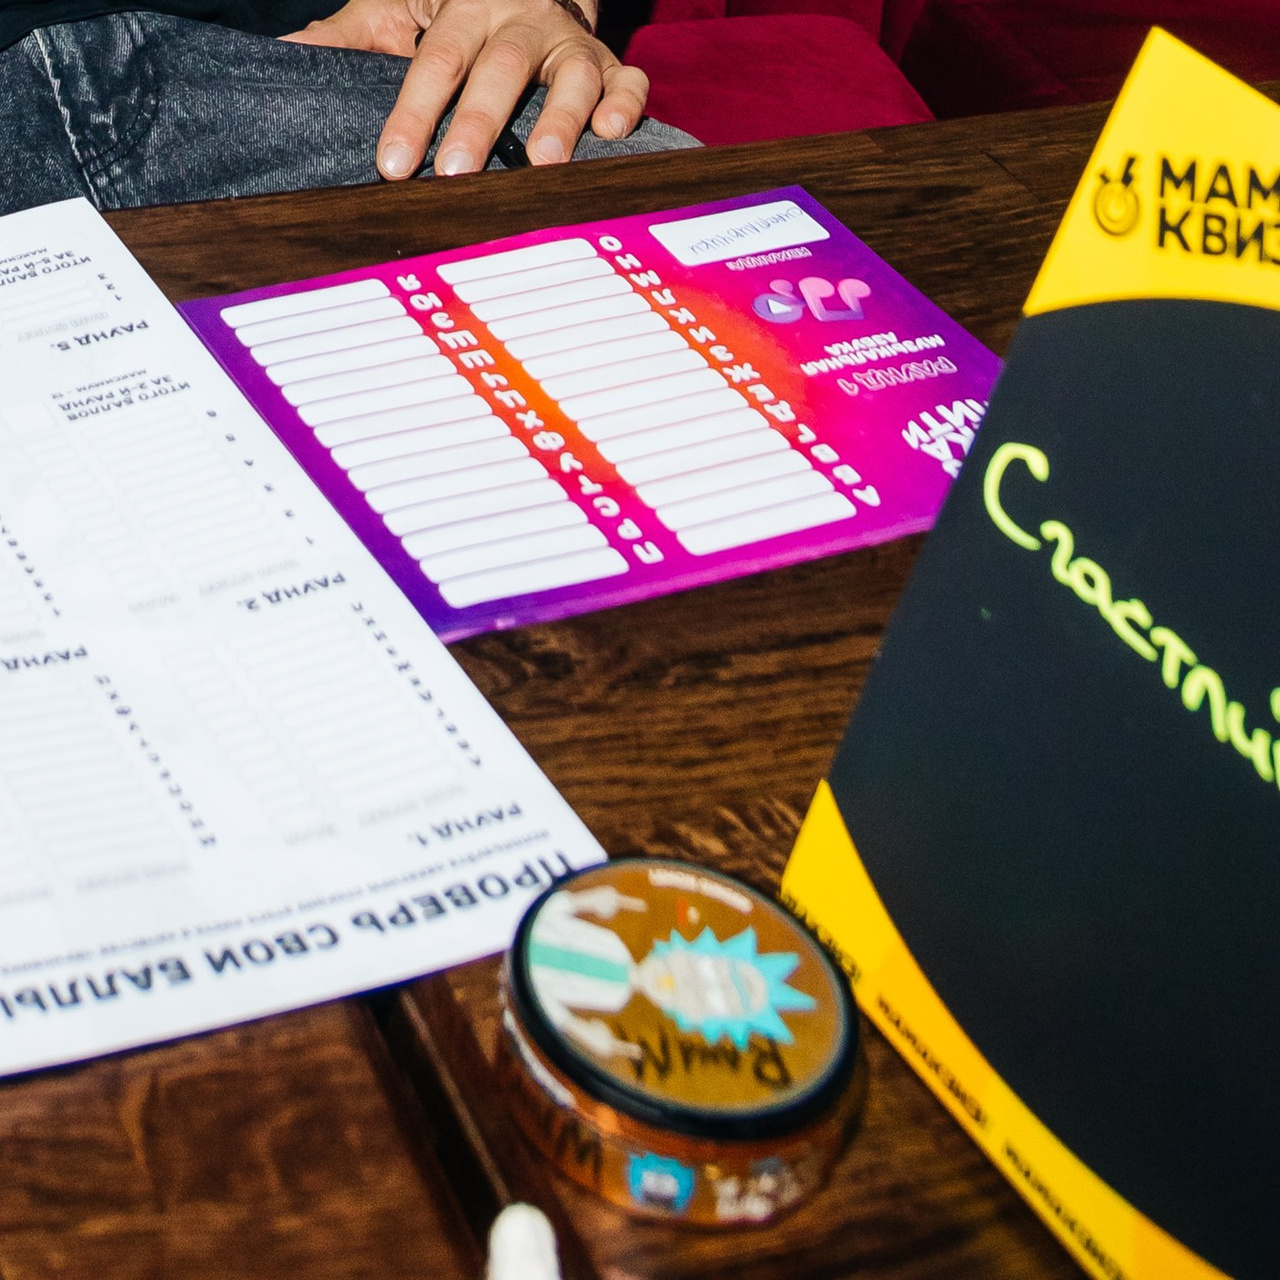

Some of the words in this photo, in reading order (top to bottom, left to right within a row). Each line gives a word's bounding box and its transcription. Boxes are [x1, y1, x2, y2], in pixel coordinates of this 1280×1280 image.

[598, 235, 623, 252] О
[1158, 206, 1280, 267] КВИ
[42, 256, 91, 274] ИТОГО
[54, 250, 75, 260] ЗА
[615, 253, 643, 270] Н
[396, 273, 422, 292] Я
[628, 270, 662, 288] М
[409, 292, 443, 311] Ю
[651, 288, 677, 306] Л
[668, 307, 697, 325] К
[73, 320, 149, 346] РАУНД
[437, 329, 479, 350] Щ
[688, 326, 717, 343] И
[823, 331, 898, 354] АЗБУКА
[458, 348, 496, 369] Ш
[709, 345, 734, 362] З
[799, 332, 945, 376] МУЗЫКАЛЬНАЯ
[150, 375, 172, 386] ЗА
[722, 363, 760, 383] Ж
[852, 356, 958, 391] РАУНД
[138, 382, 190, 401] ИТОГО
[747, 383, 775, 402] Е
[836, 378, 860, 397] 1
[58, 392, 115, 412] РАУНД
[66, 397, 134, 421] БАЛЛОВ
[493, 389, 527, 408] Ц
[515, 410, 545, 430] Х
[763, 400, 797, 422] Д
[532, 430, 566, 451] Ф
[797, 423, 817, 444] Г
[559, 452, 583, 473] У
[578, 475, 603, 495] Т
[852, 485, 881, 507] А
[592, 496, 621, 518] С
[617, 518, 643, 540] Р
[632, 541, 665, 565] П
[262, 572, 345, 606] РАУНД
[984, 442, 1280, 790] Счастли
[0, 647, 87, 672] РАУНД
[432, 804, 522, 840] РАУНД
[351, 852, 576, 936] ПРОВЕРЬ
[204, 923, 340, 975] СВОИ
